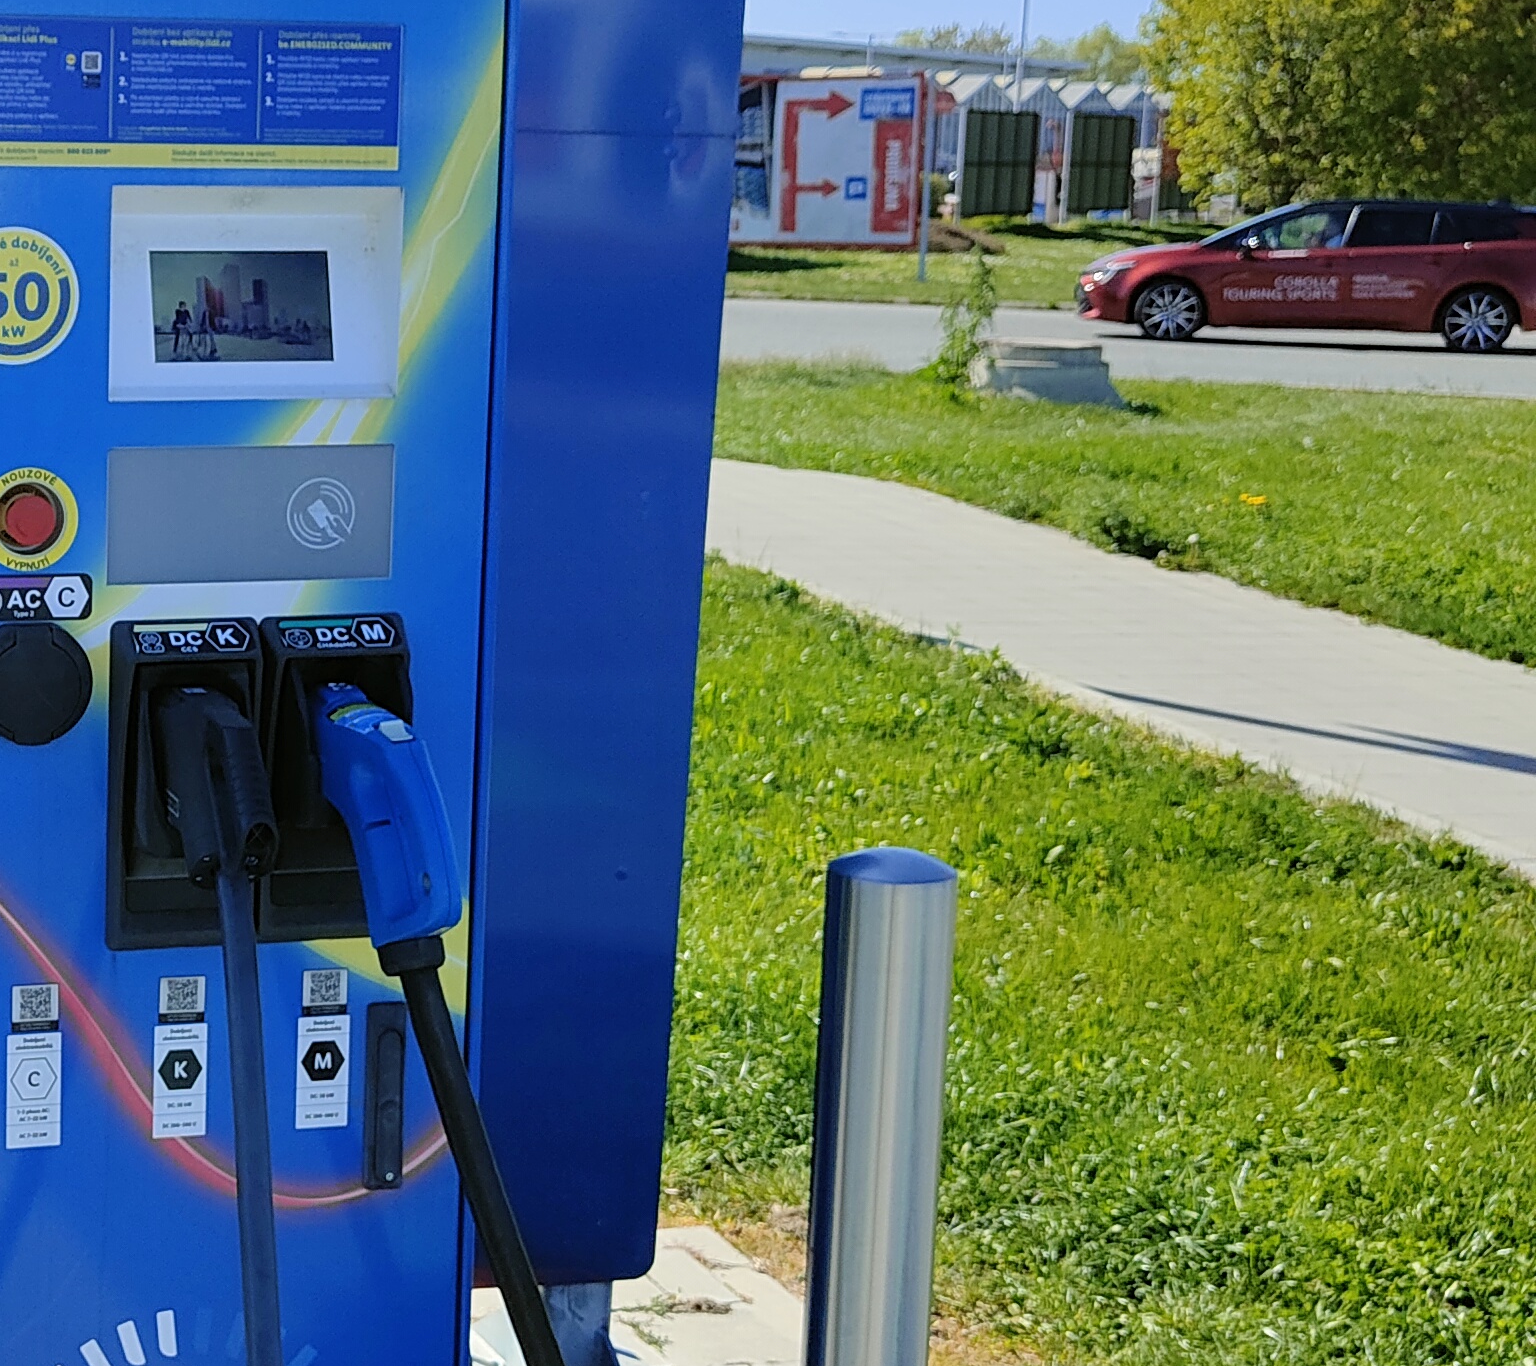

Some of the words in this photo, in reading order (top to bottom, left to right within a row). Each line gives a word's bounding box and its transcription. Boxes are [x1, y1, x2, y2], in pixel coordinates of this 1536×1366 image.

[1273, 275, 1340, 290] COROLLA
[1222, 287, 1284, 302] TOURING
[1285, 288, 1338, 302] SPORTS
[1, 325, 26, 338] kW
[0, 469, 58, 486] NOUZOVÉ
[6, 554, 51, 571] VYPNUTÍ
[7, 589, 42, 610] AC
[57, 586, 76, 608] C
[169, 631, 204, 647] DC
[215, 627, 240, 646] K
[315, 627, 350, 642] DC
[360, 622, 387, 642] M
[173, 1059, 189, 1080] K
[313, 1051, 333, 1071] M
[27, 1070, 42, 1088] C
